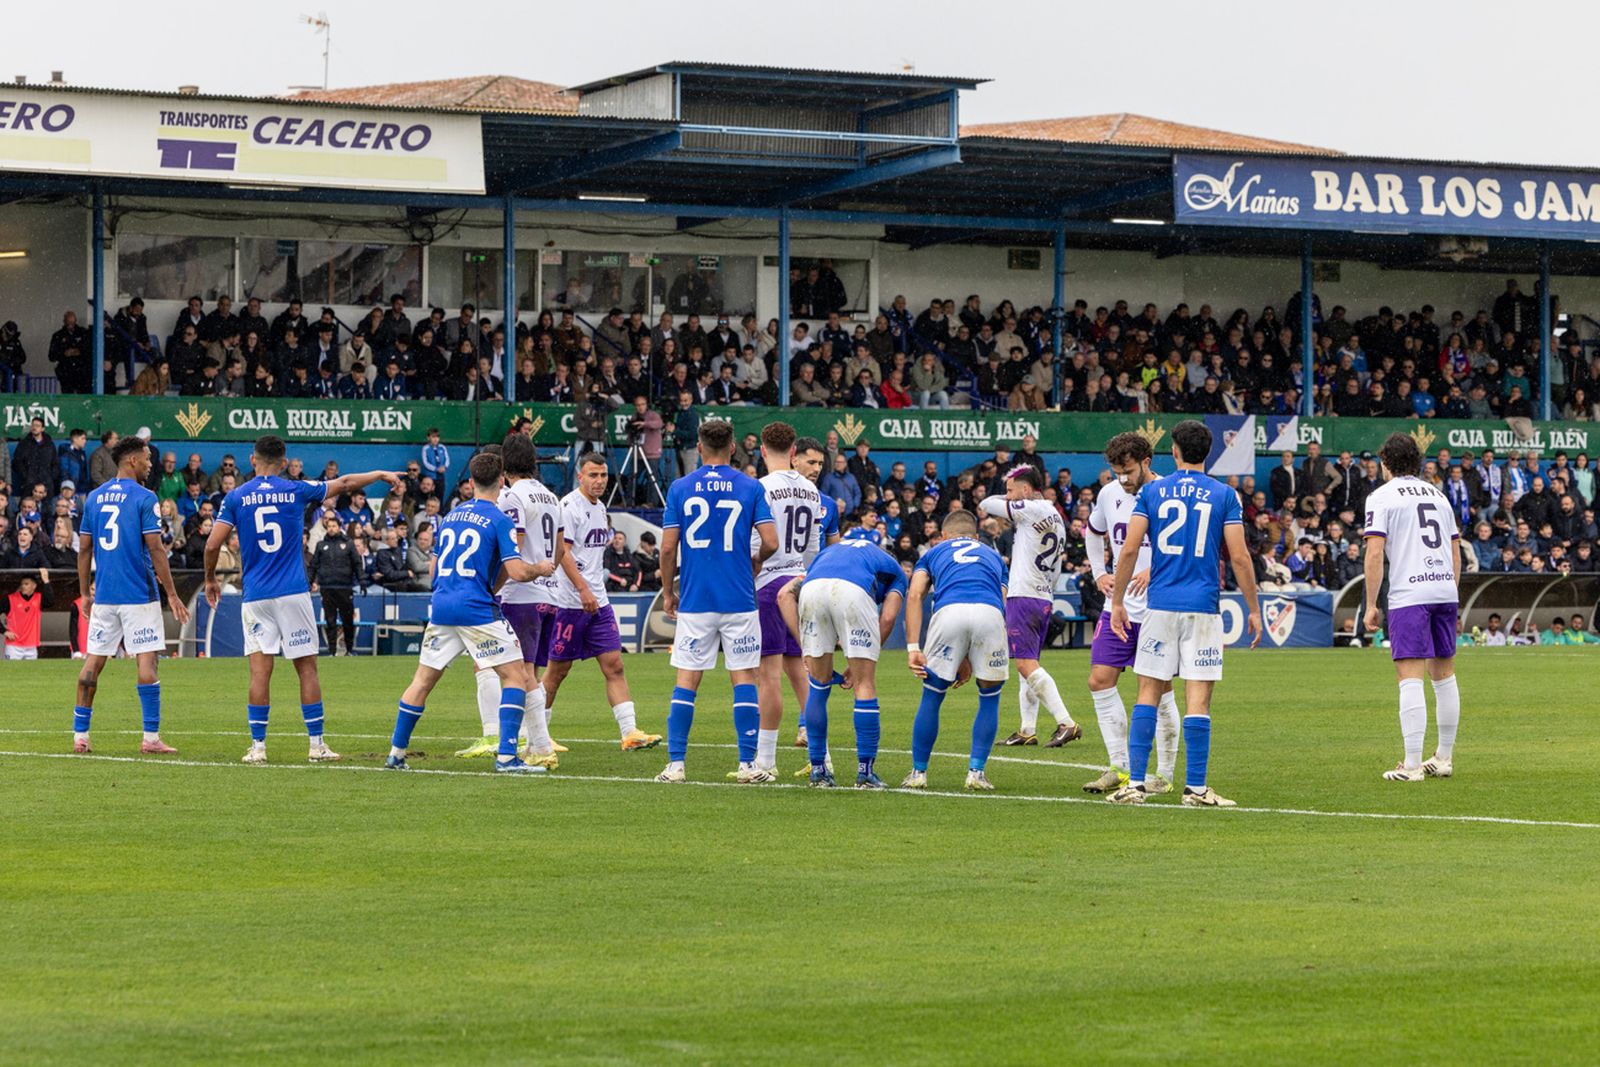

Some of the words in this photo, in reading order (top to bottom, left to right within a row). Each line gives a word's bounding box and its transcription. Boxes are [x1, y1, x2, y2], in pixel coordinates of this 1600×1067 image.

[160, 110, 248, 130] TRANSPORTES
[252, 115, 432, 152] CEACERO
[1311, 170, 1409, 215] BAR
[1418, 175, 1503, 219] LOS
[1514, 180, 1600, 223] JAM
[228, 409, 279, 430] CAJA
[286, 409, 356, 430] RURAL
[362, 406, 412, 431] JAÉN
[879, 419, 923, 439] CAJA
[930, 420, 991, 440] RURAL
[996, 418, 1040, 440] JAÉN
[932, 439, 990, 447] www.ruralvia.com
[1448, 429, 1487, 447] CAJA
[1549, 428, 1588, 449] JAÉN
[695, 481, 704, 491] A.
[707, 480, 733, 492] COVA
[769, 487, 792, 501] AGUS
[1159, 487, 1170, 498] V.
[1173, 483, 1212, 501] LÓPEZ
[242, 492, 263, 506] JOÃO
[266, 492, 295, 504] PAULO
[99, 504, 120, 551] 3
[254, 505, 282, 553] 5
[541, 512, 554, 558] 9
[683, 496, 743, 552] 27
[783, 505, 813, 554] 19
[1157, 499, 1212, 557] 21
[1417, 503, 1442, 549] 5
[437, 528, 481, 577] 22
[951, 540, 981, 564] 2
[556, 622, 574, 642] 14
